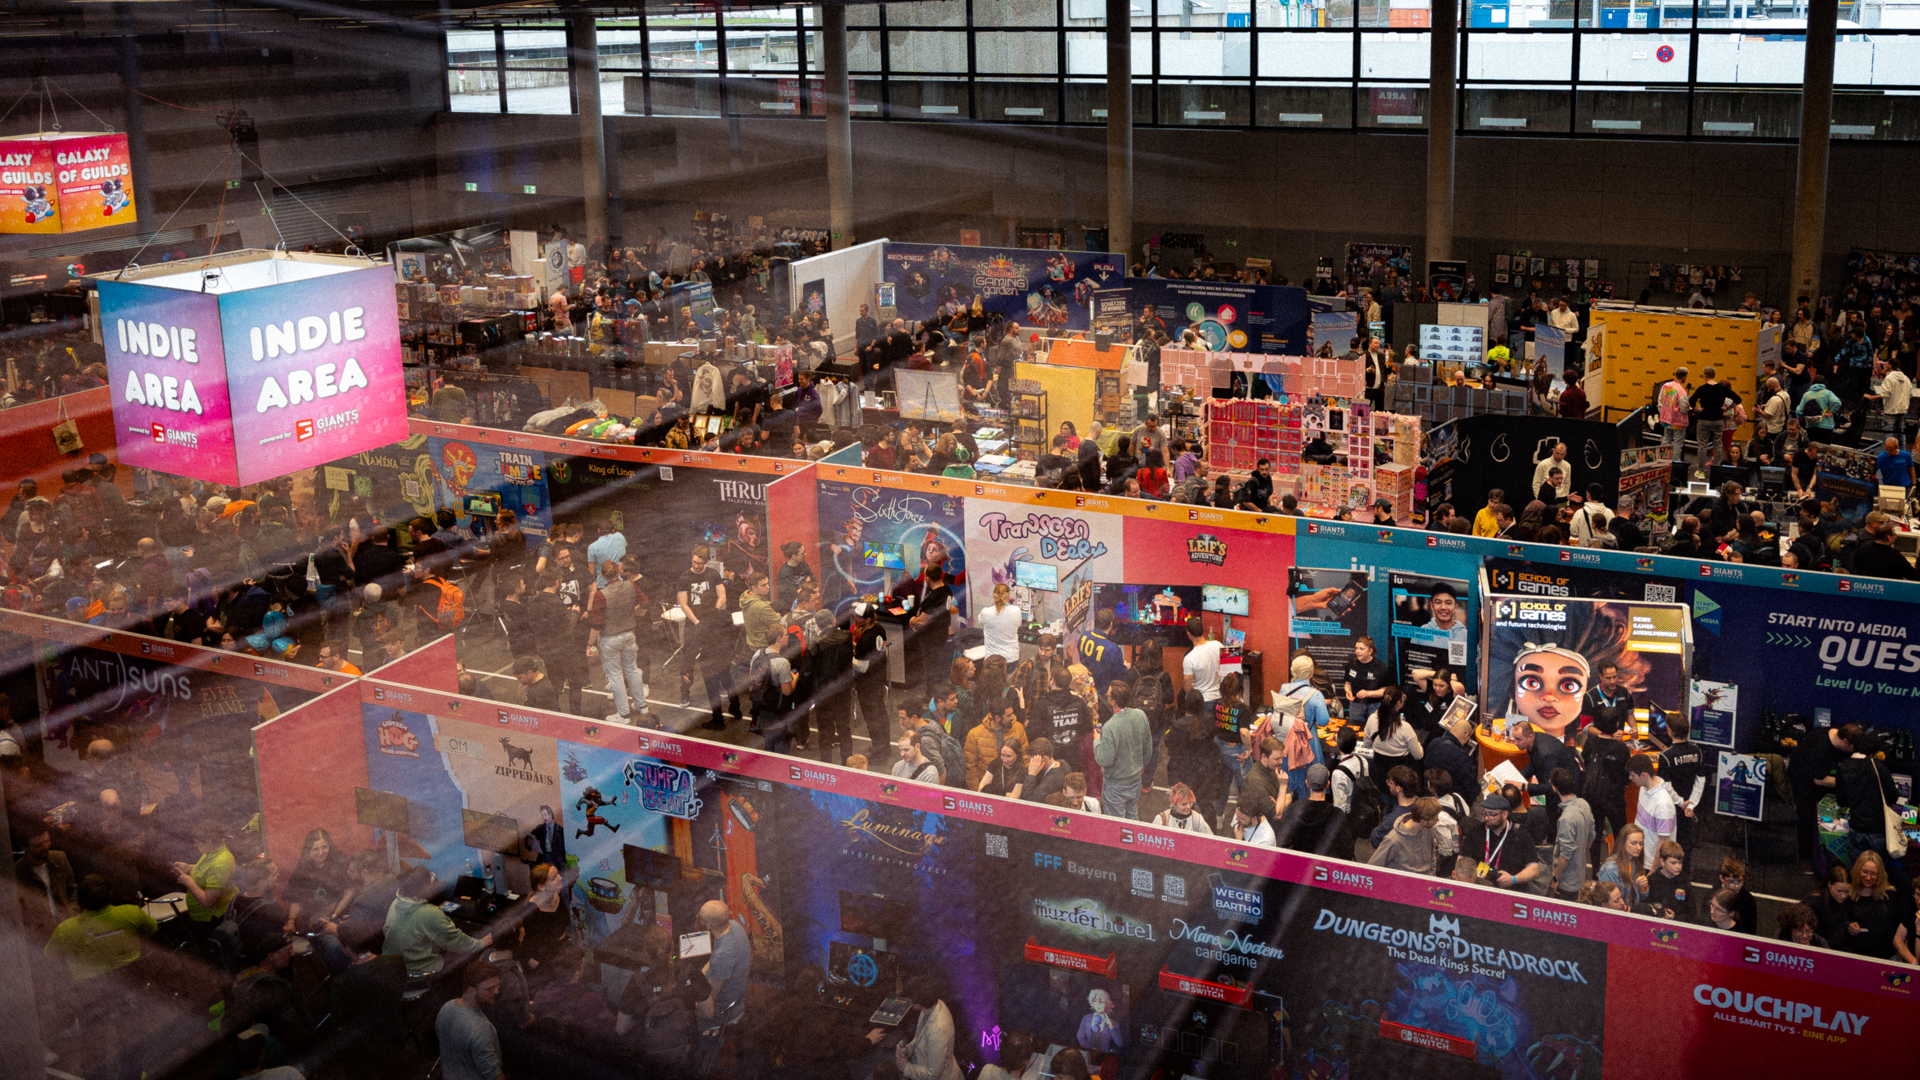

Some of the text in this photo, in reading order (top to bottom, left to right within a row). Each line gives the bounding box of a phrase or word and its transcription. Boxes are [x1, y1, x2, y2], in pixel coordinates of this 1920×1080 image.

[57, 148, 110, 166] GALAXY
[2, 171, 53, 185] GUILDS
[59, 163, 129, 184] OF GUILDS
[887, 254, 925, 262] RECHARGE
[1093, 264, 1115, 272] PLAY
[975, 276, 1027, 290] GAMING
[982, 285, 1019, 299] garden
[117, 318, 199, 363] INDIE
[250, 306, 366, 362] INDIE
[125, 369, 203, 415] AREA
[256, 357, 368, 413] AREA
[317, 409, 359, 430] GIANTS
[128, 426, 151, 436] powered by
[318, 420, 359, 434] SOFTWARE
[166, 428, 197, 444] GIANTS
[259, 431, 291, 445] powered by
[167, 440, 198, 449] SOFTWARE
[499, 451, 533, 466] TRAIN
[691, 454, 712, 463] GIANTS
[494, 458, 542, 480] JUMBLE
[588, 464, 635, 479] King of Lings
[882, 475, 903, 483] GIANTS
[1620, 470, 1657, 490] SOFTWARE
[984, 487, 1007, 496] GIANTS
[1086, 498, 1109, 508] GIANTS
[1199, 511, 1224, 521] GIANTS
[1319, 525, 1345, 535] GIANTS
[1187, 538, 1228, 557] LEIF'S
[1439, 538, 1466, 547] GIANTS
[1191, 552, 1224, 563] ADVENTURE
[1573, 553, 1601, 562] GIANTS
[1518, 572, 1569, 586] SCHOOL OF
[1713, 567, 1743, 578] GIANTS
[1518, 582, 1569, 597] Games
[1853, 582, 1884, 592] GIANTS
[1519, 602, 1566, 611] SCHOOL OF
[1519, 610, 1567, 622] Games
[1700, 617, 1720, 625] MEDIA
[1528, 622, 1567, 630] technologies
[1767, 612, 1907, 639] START INTO MEDIA
[151, 644, 175, 656] GIANTS
[1079, 635, 1105, 662] 101
[264, 666, 289, 678] GIANTS
[200, 685, 239, 700] EVER
[1815, 675, 1908, 697] Level Up Your
[385, 689, 412, 703] GIANTS
[200, 700, 247, 717] FLAME
[510, 713, 539, 726] GIANTS
[1053, 718, 1078, 728] TEAM
[652, 740, 681, 752] GIANTS
[494, 764, 554, 785] ZIPPEDÄUS
[633, 760, 679, 790] JUMP
[678, 769, 692, 795] A
[804, 769, 836, 783] GIANTS
[644, 788, 690, 815] BEAT
[958, 799, 994, 813] GIANTS
[1137, 832, 1175, 847] GIANTS
[1138, 841, 1175, 851] SOFTWARE
[1035, 852, 1117, 882] FFF Bayern
[1332, 870, 1373, 886] GIANTS
[1332, 879, 1373, 890] SOFTWARE
[1035, 898, 1048, 907] the
[1168, 897, 1188, 906] Discord
[1215, 887, 1260, 904] WEGEN
[1215, 899, 1261, 916] BARTHO
[1035, 904, 1156, 942] murder hotel
[1217, 911, 1259, 926] games
[1532, 907, 1577, 925] GIANTS
[1533, 916, 1577, 928] SOFTWARE
[1169, 917, 1285, 960] Mare Noctem
[1313, 908, 1588, 984] DUNGEONS OF DREADROCK
[1054, 953, 1087, 963] NINTENDO
[1195, 945, 1258, 969] cardgame
[1386, 946, 1506, 980] The Dead King's Secret
[1766, 951, 1814, 969] GIANTS
[1766, 961, 1814, 974] SOFTWARE
[1190, 982, 1224, 993] NINTENDO
[1693, 983, 1870, 1035] COUCHPLAY
[1713, 1012, 1737, 1023] ALLE
[1738, 1016, 1772, 1030] SMART
[1802, 1030, 1825, 1041] EINE
[1826, 1033, 1847, 1044] APP
[1413, 1031, 1449, 1044] NINTENDO
